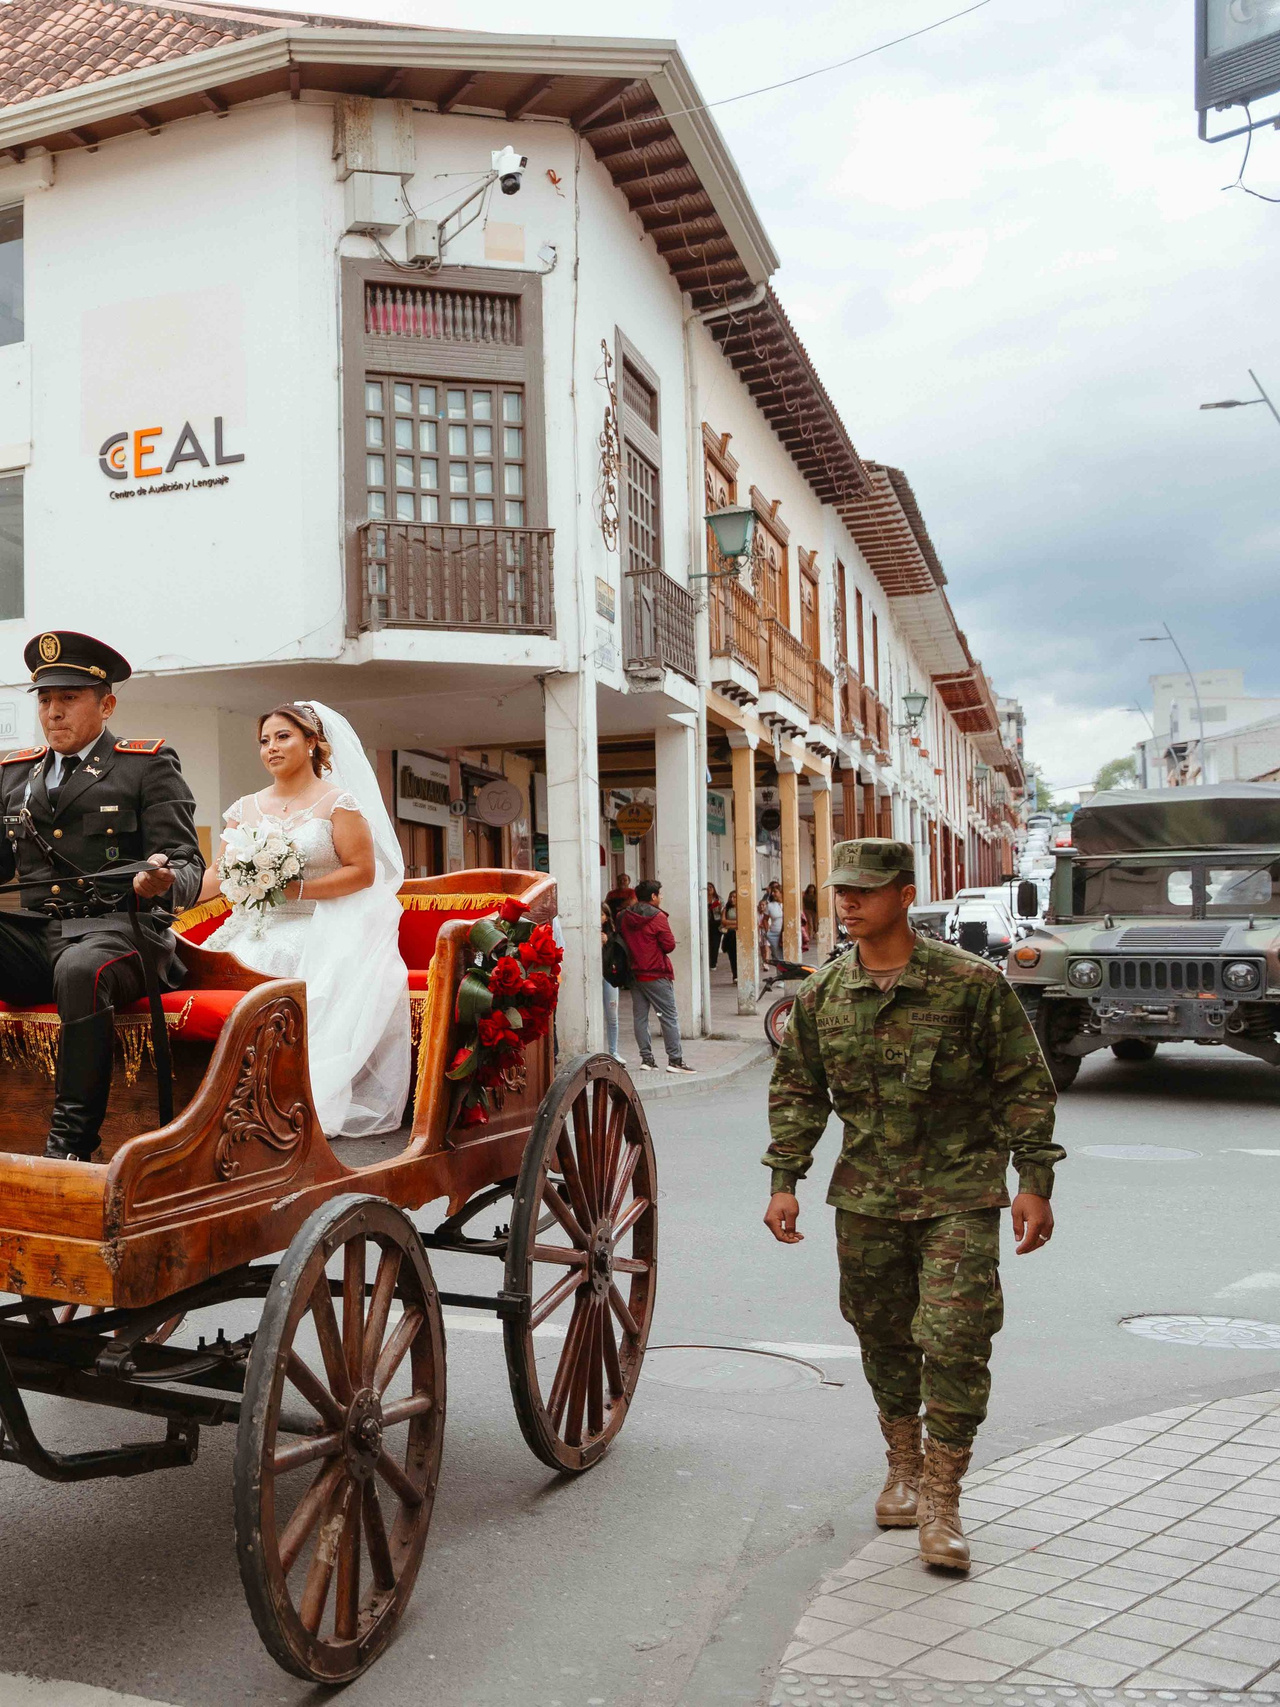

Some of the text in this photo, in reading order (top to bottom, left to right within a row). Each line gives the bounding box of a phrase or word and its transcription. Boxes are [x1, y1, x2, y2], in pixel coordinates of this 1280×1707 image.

[99, 416, 245, 480] CEAL
[109, 475, 229, 500] Centro de Audición y Lenguaje
